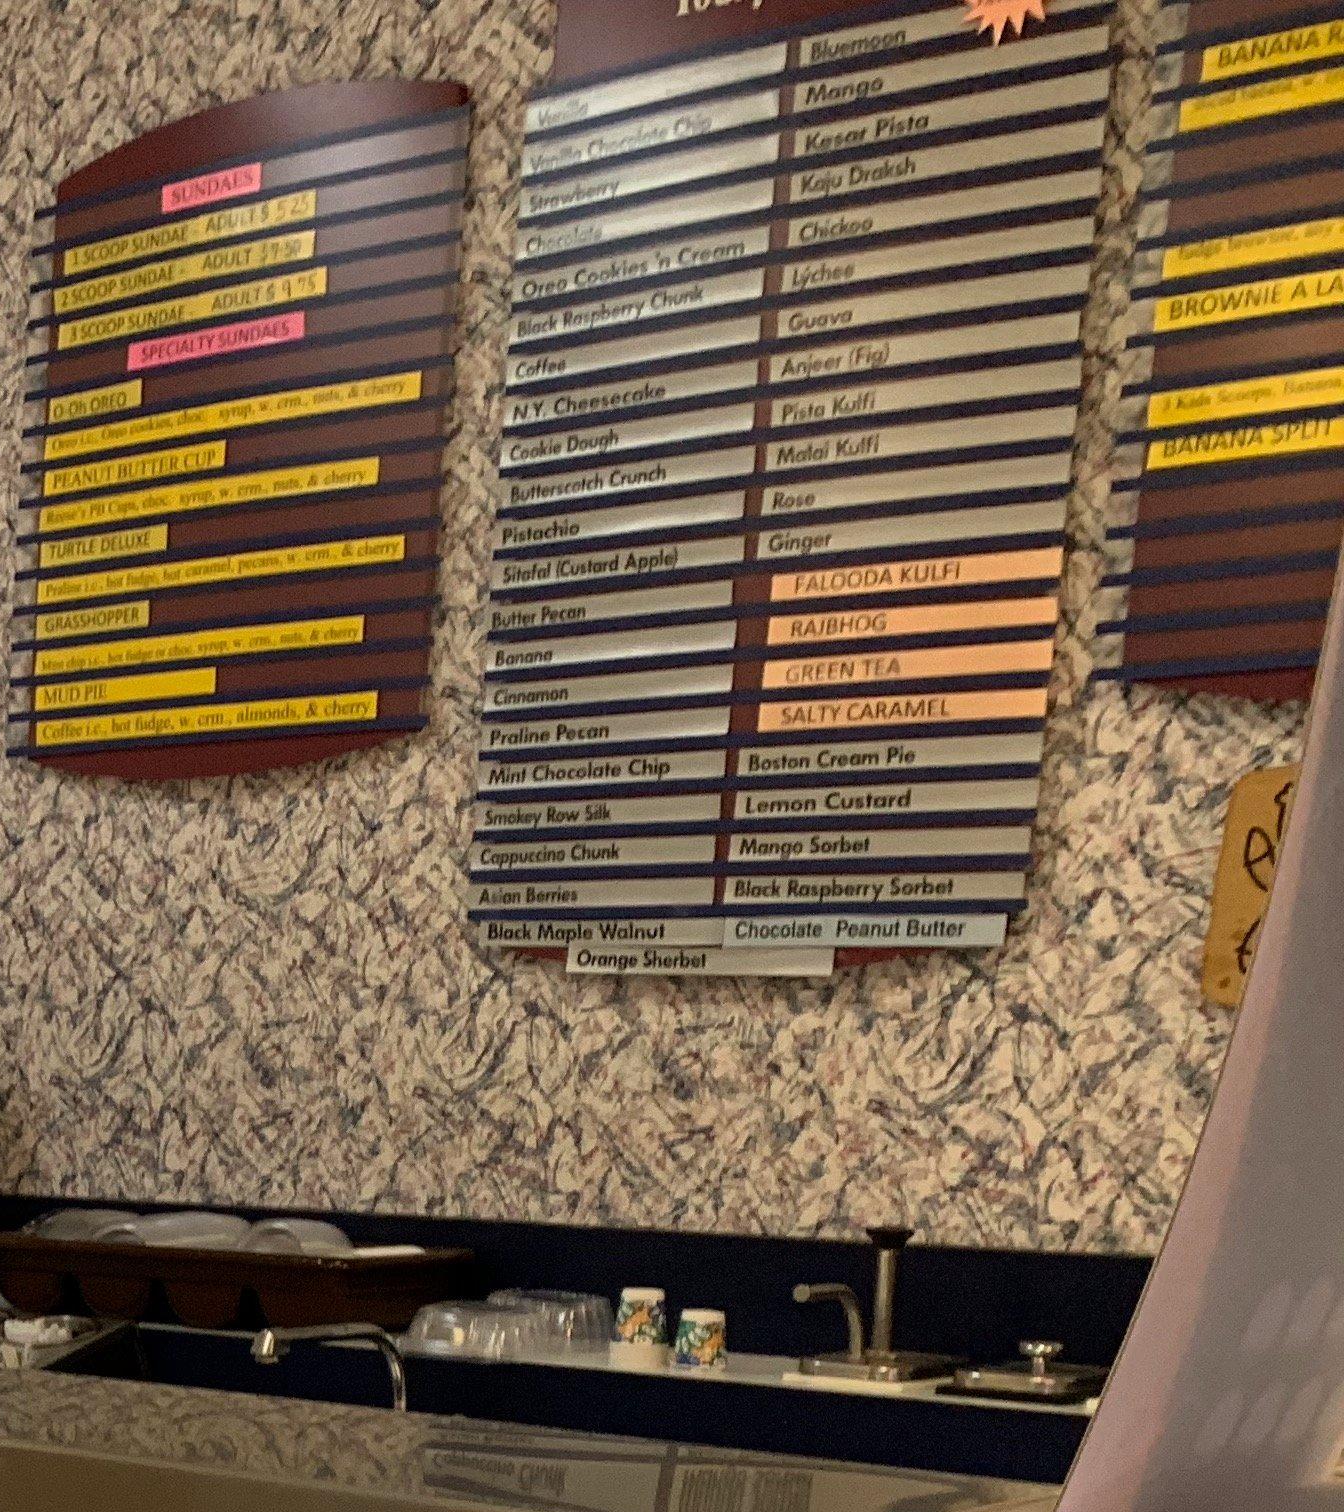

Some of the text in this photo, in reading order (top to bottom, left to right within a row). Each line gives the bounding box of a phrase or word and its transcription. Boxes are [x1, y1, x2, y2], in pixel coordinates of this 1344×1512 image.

[1218, 29, 1320, 69] BANANA
[806, 77, 884, 105] Mango
[804, 113, 930, 151] Kesar Pista
[171, 170, 254, 203] SUNDAES
[82, 208, 254, 263] SCOOP SUNDAE ADULT
[799, 216, 873, 243] Chickoo
[72, 248, 252, 304] SCOOP SUNDAE ADULT
[574, 258, 648, 288] Cookies
[678, 240, 745, 267] Cream
[1169, 275, 1344, 321] BROWNIE A LA
[80, 286, 261, 339] SCOOP SUNDAE ADULT
[517, 286, 704, 338] Black Raspberry Chunk
[788, 309, 853, 332] Guava
[141, 321, 290, 363] SPECIALTY SUNDAES
[515, 358, 567, 379] Coffee
[781, 353, 841, 378] Anjeer
[364, 380, 406, 401] cherry
[553, 383, 666, 415] Cheesecake
[782, 391, 876, 424] Pista Kulfi
[511, 428, 619, 462] Cookie Dough
[777, 432, 881, 465] Malai Kulfi
[1163, 417, 1332, 459] BANANA SPLIT
[52, 448, 216, 490] PEANUT BUTTER CUP
[323, 467, 367, 487] cherry
[512, 464, 667, 501] Butterscotch Crunch
[773, 491, 816, 510] Rose
[49, 530, 151, 561] TURTLE DELUXE
[502, 520, 580, 545] Pistachio
[768, 530, 832, 553] Ginger
[357, 538, 400, 559] cherry
[555, 546, 679, 577] (Custard Apple)
[795, 561, 962, 594] FALOODA KULFI
[44, 605, 140, 633] GRASSHOPPER
[492, 604, 586, 629] Butter Pecan
[791, 613, 888, 639] RAJBHOG
[495, 649, 553, 667] Banana
[785, 657, 901, 685] GREEN TEA
[43, 683, 107, 706] MUD PIE
[493, 687, 568, 706] Cinnamon
[42, 696, 371, 741] Coffee hot & cherry
[781, 698, 950, 725] SALTY CARAMEL
[490, 723, 610, 747] Praline Pecan
[489, 757, 671, 785] Mint Chocolate Chip
[748, 745, 916, 772] Boston Cream Pie
[745, 788, 912, 814] Lemon Custard
[484, 803, 611, 828] Smokey Row Silk
[480, 843, 620, 869] Cappuccino Chunk
[739, 835, 870, 860] Mango Sorbet
[479, 886, 578, 906] Asian Berries
[734, 875, 954, 902] Black Raspberry Sorbet
[487, 921, 666, 944] Black Maple Walnut
[735, 917, 967, 940] Chocolate Peanut Butter
[576, 949, 707, 972] Orange Sherbet
